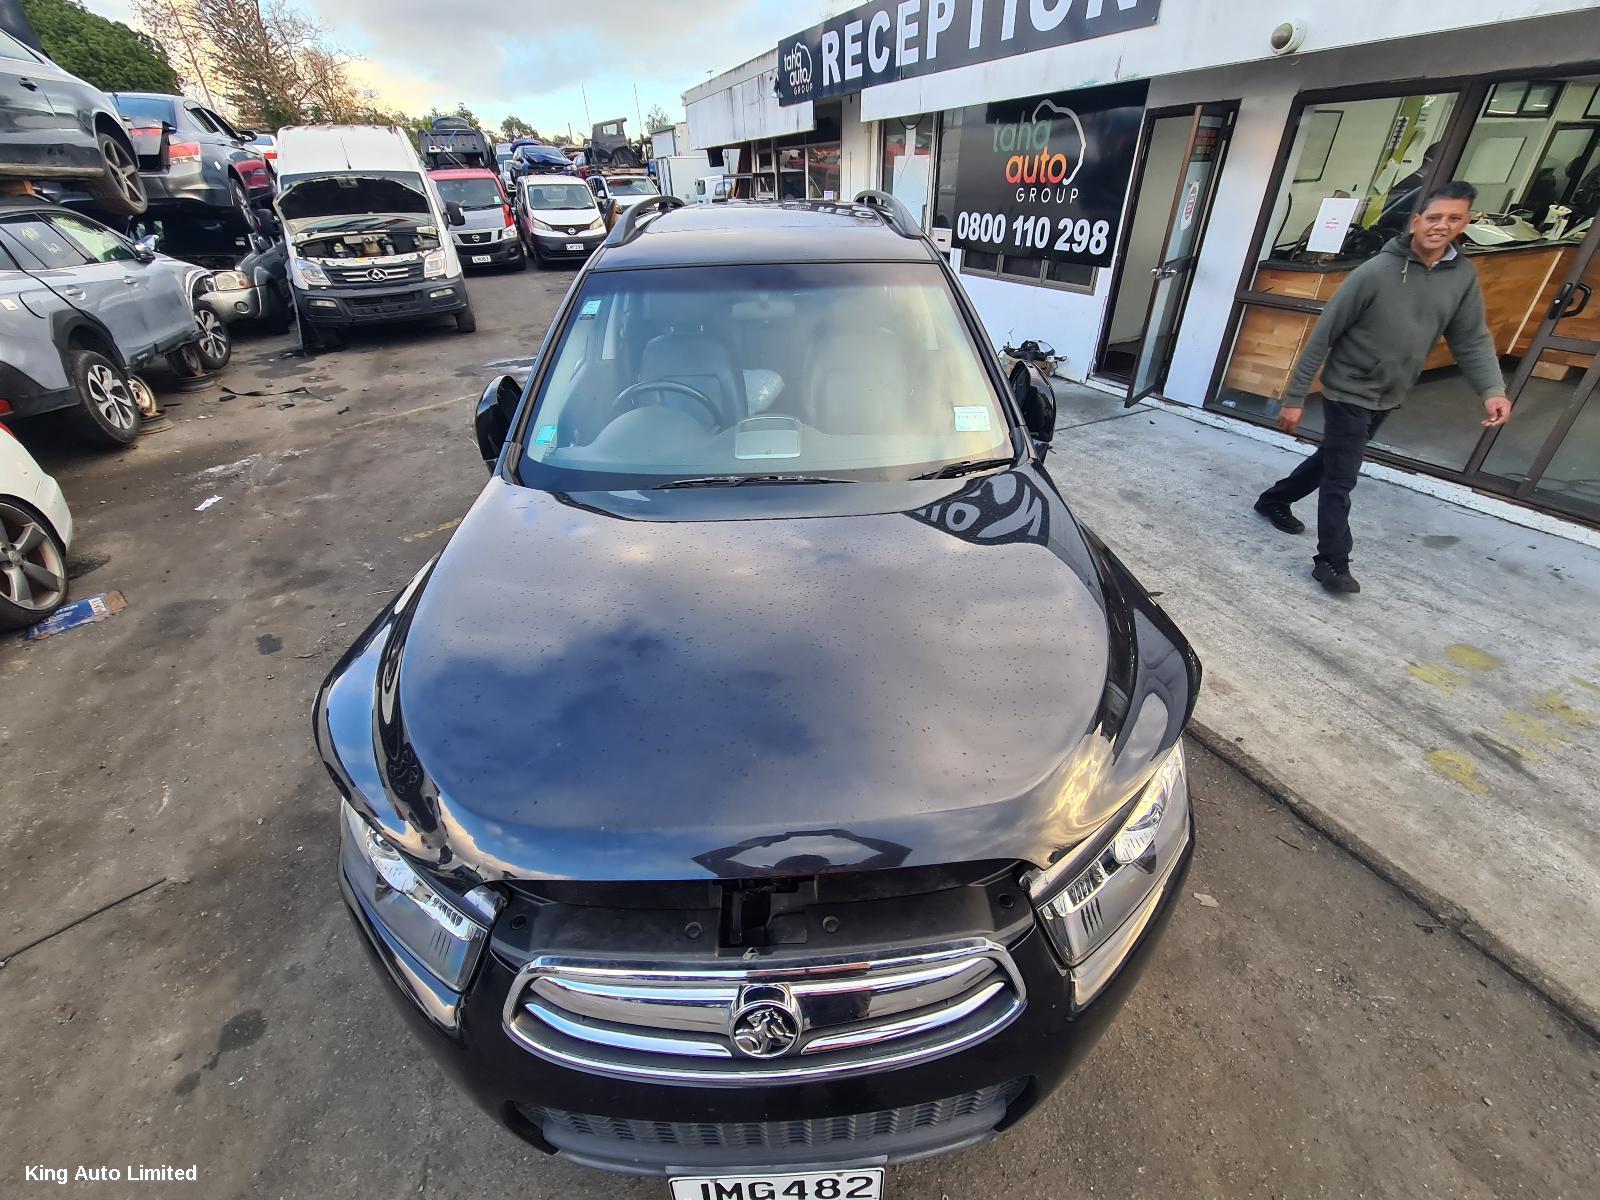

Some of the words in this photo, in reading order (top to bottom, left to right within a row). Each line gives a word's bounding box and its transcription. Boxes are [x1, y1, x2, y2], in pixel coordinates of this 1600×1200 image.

[821, 0, 1138, 87] RECEPTI
[783, 48, 802, 72] taha
[789, 67, 808, 86] auto
[793, 82, 813, 96] GROUP
[992, 110, 1053, 153] taha
[1005, 146, 1067, 184] auto
[1015, 187, 1079, 204] GROUP
[957, 211, 1007, 244] 0800
[1012, 214, 1051, 249] 110
[1053, 217, 1110, 255] 298
